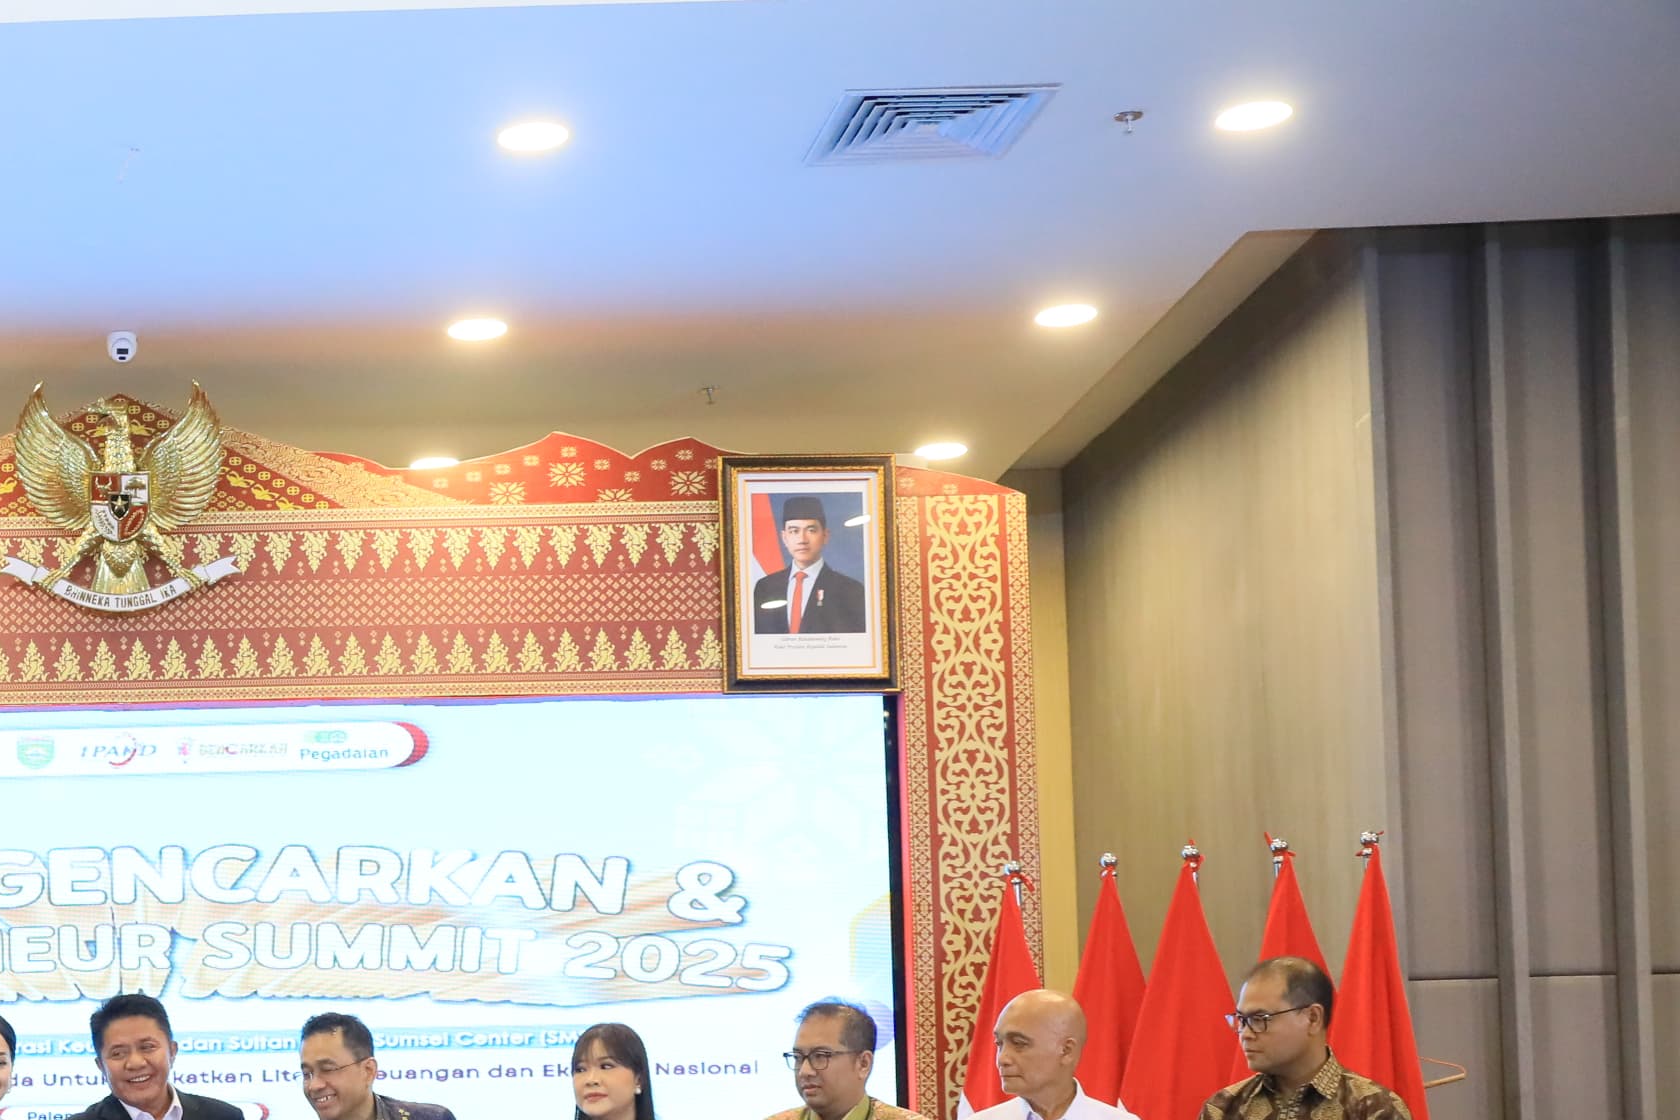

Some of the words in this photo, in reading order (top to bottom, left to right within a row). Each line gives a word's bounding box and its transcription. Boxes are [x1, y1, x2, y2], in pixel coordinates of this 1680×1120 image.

[64, 585, 110, 608] BHINNEKA
[114, 594, 157, 609] TUNGGAL
[160, 584, 177, 599] IKA
[299, 746, 389, 760] Pegadaian
[666, 860, 748, 925] &
[202, 921, 538, 974] SUMMIT
[564, 930, 793, 992] 2025
[180, 1036, 224, 1051] dan
[228, 1034, 298, 1051] Sultan
[373, 1032, 450, 1048] Sumsel
[454, 1031, 534, 1047] Center
[376, 1066, 480, 1082] euangan
[488, 1064, 534, 1079] dan
[655, 1060, 758, 1075] Nasional
